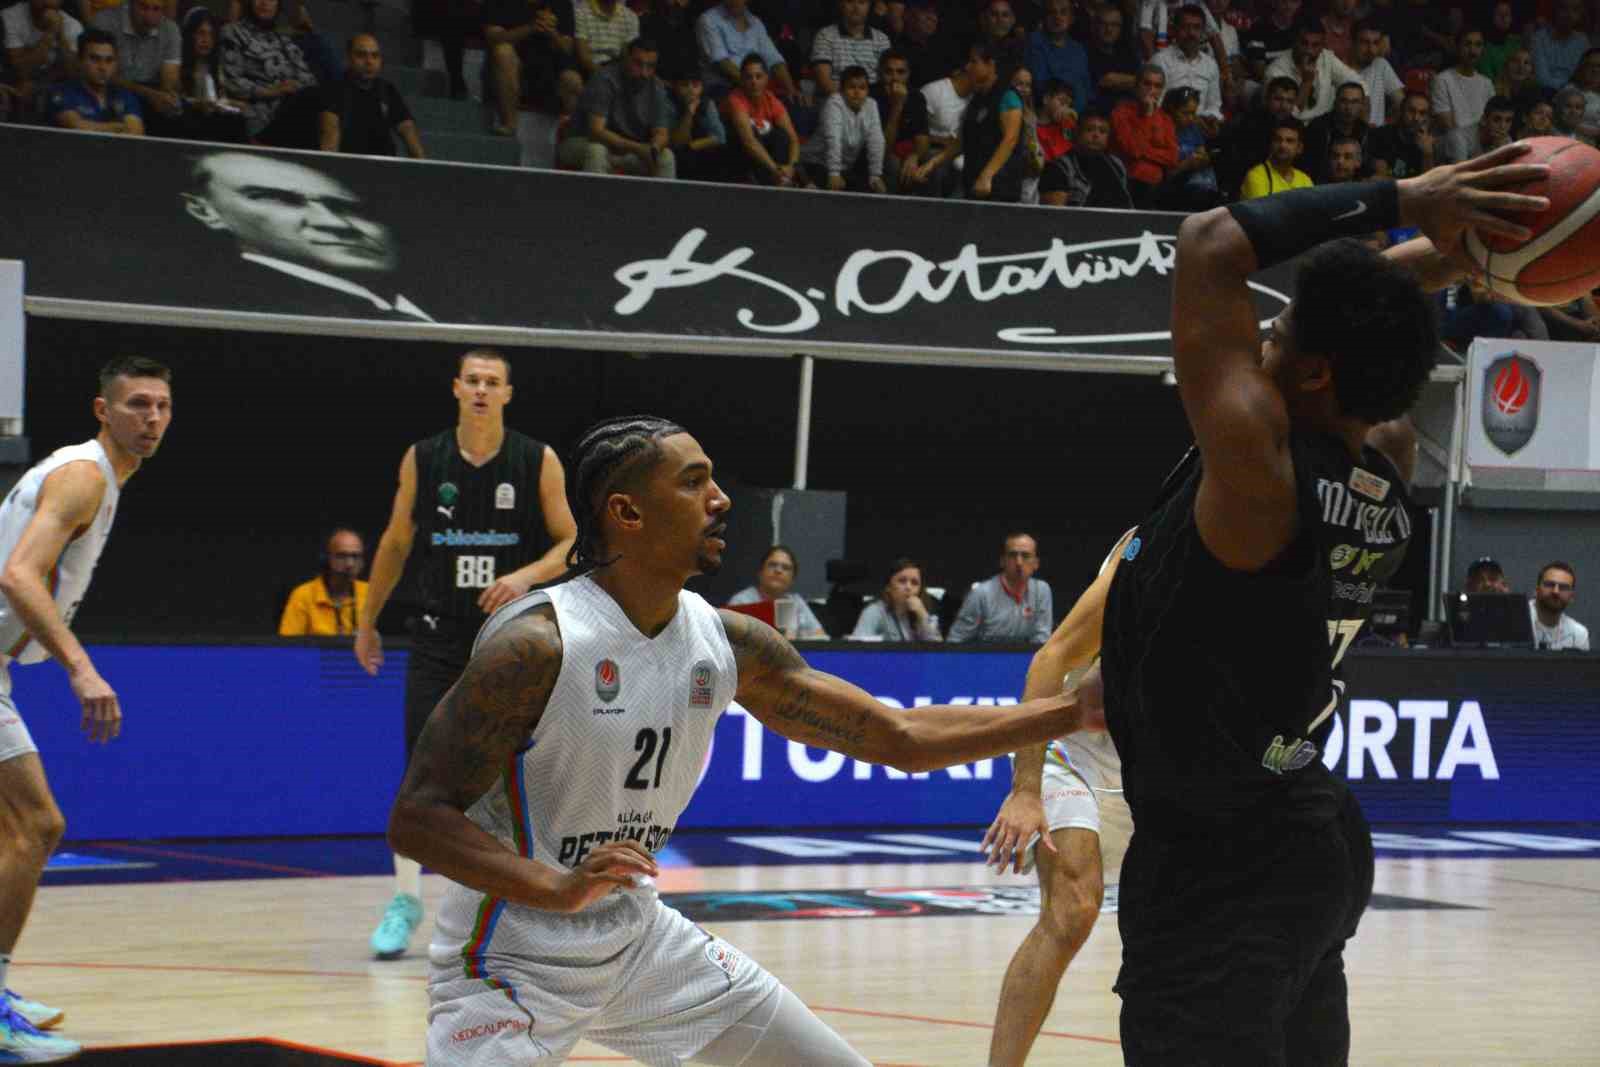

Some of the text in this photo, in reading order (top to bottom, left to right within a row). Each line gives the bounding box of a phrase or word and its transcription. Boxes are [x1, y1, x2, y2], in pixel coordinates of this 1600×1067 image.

[457, 556, 496, 588] 88
[624, 727, 671, 789] 21
[1322, 700, 1500, 779] RTA
